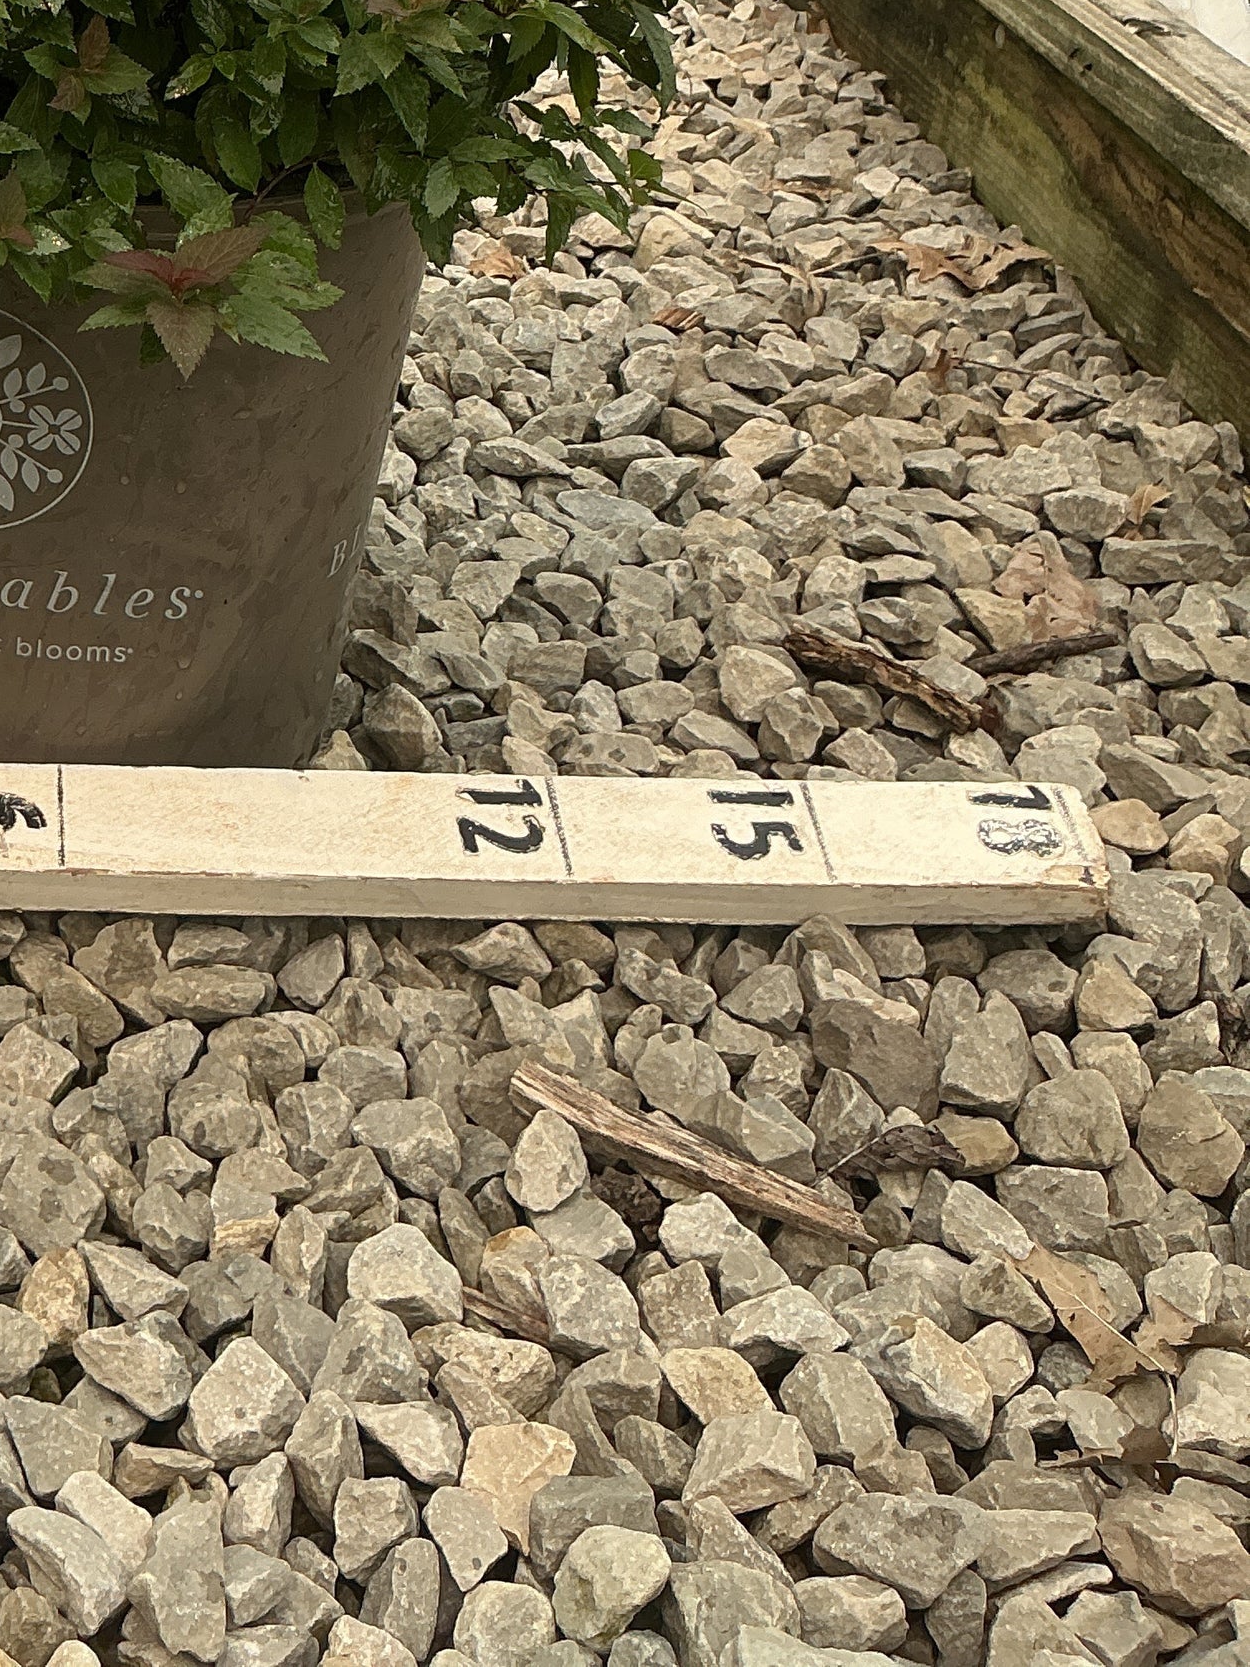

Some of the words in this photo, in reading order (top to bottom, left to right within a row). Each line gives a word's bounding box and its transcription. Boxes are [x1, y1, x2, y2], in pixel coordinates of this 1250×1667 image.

[455, 779, 545, 857] 12
[706, 786, 805, 861] 15
[966, 783, 1066, 860] 18
